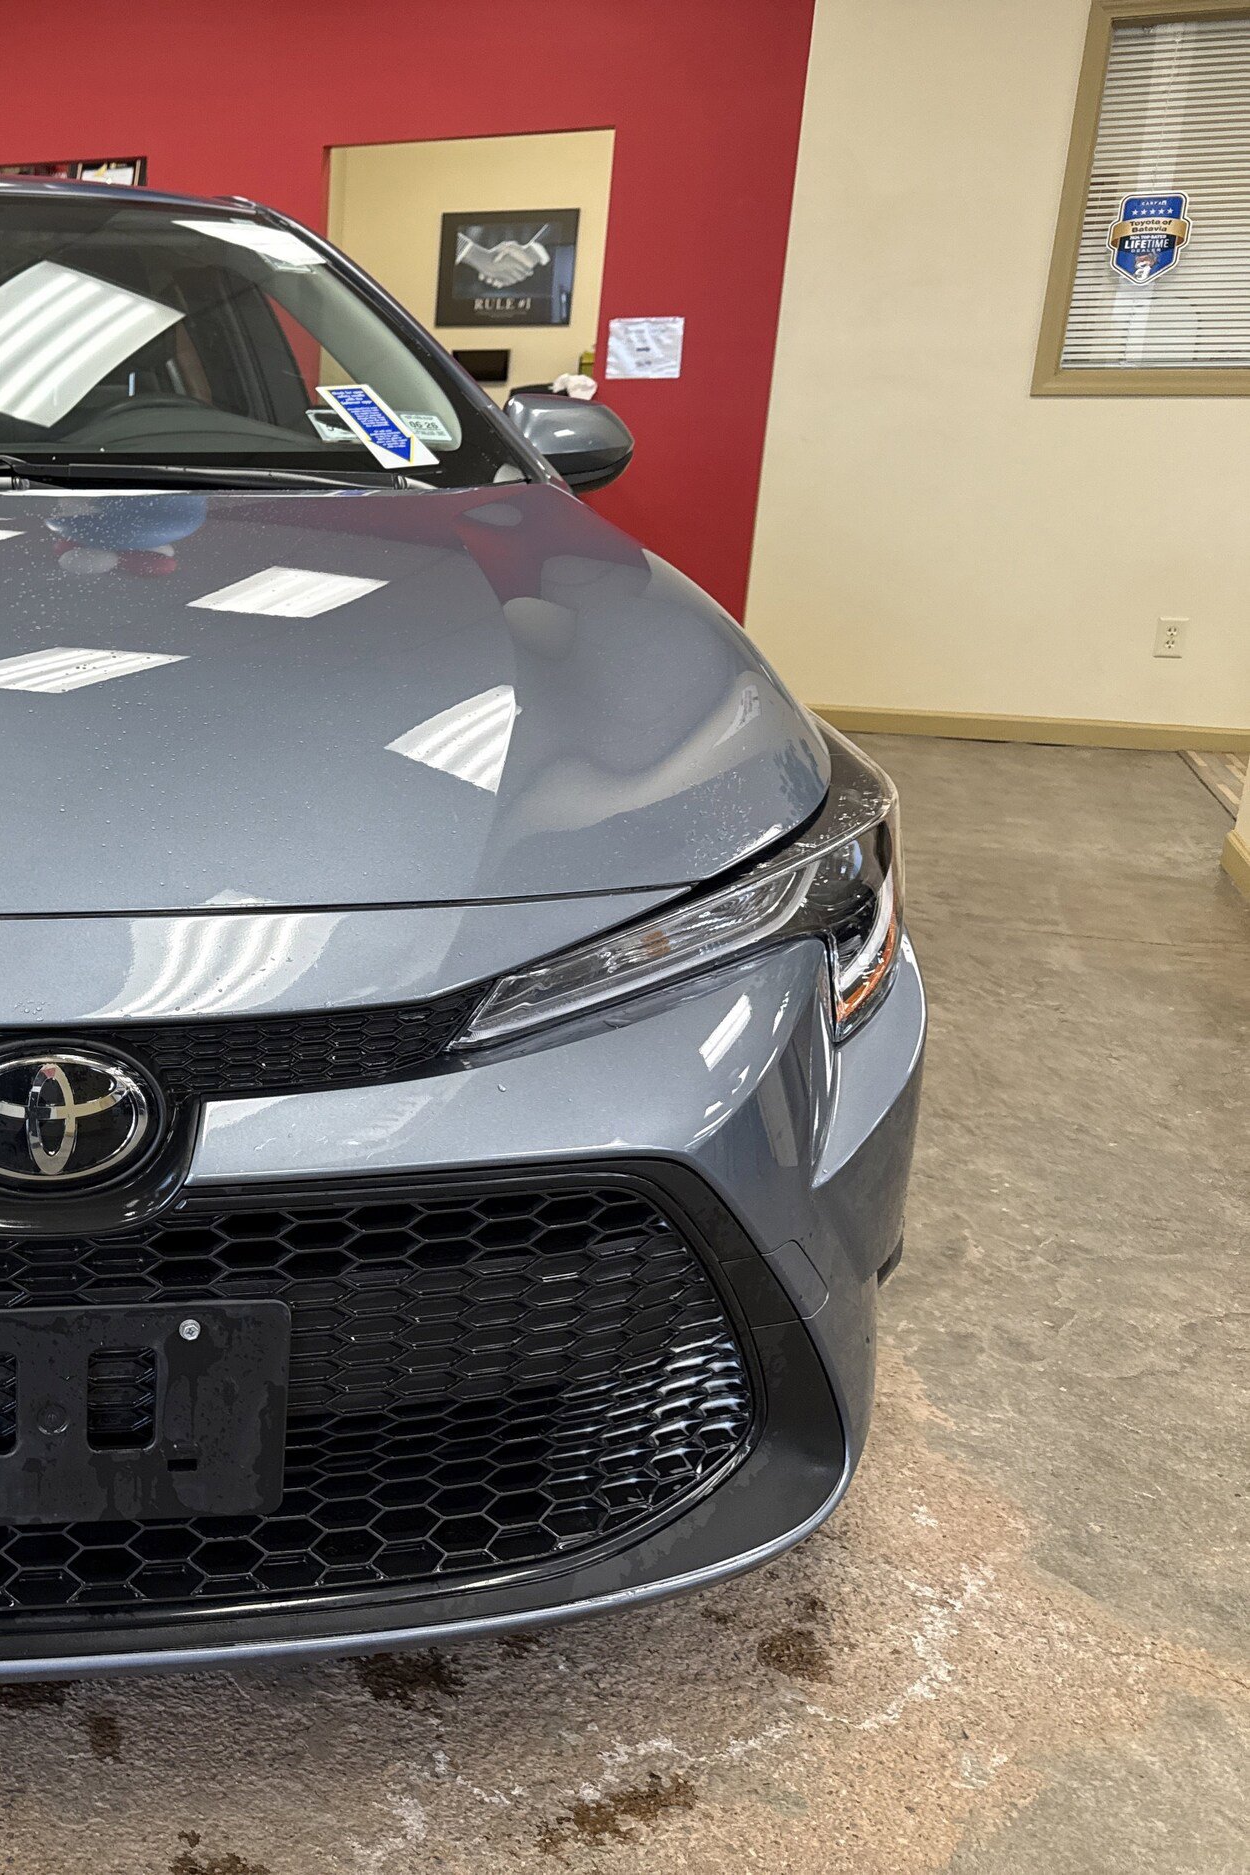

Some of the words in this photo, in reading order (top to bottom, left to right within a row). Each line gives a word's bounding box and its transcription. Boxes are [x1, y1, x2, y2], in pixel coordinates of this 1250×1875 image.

[1130, 219, 1161, 227] Toyota
[1125, 239, 1169, 249] LIFETIME
[474, 297, 514, 310] RULE
